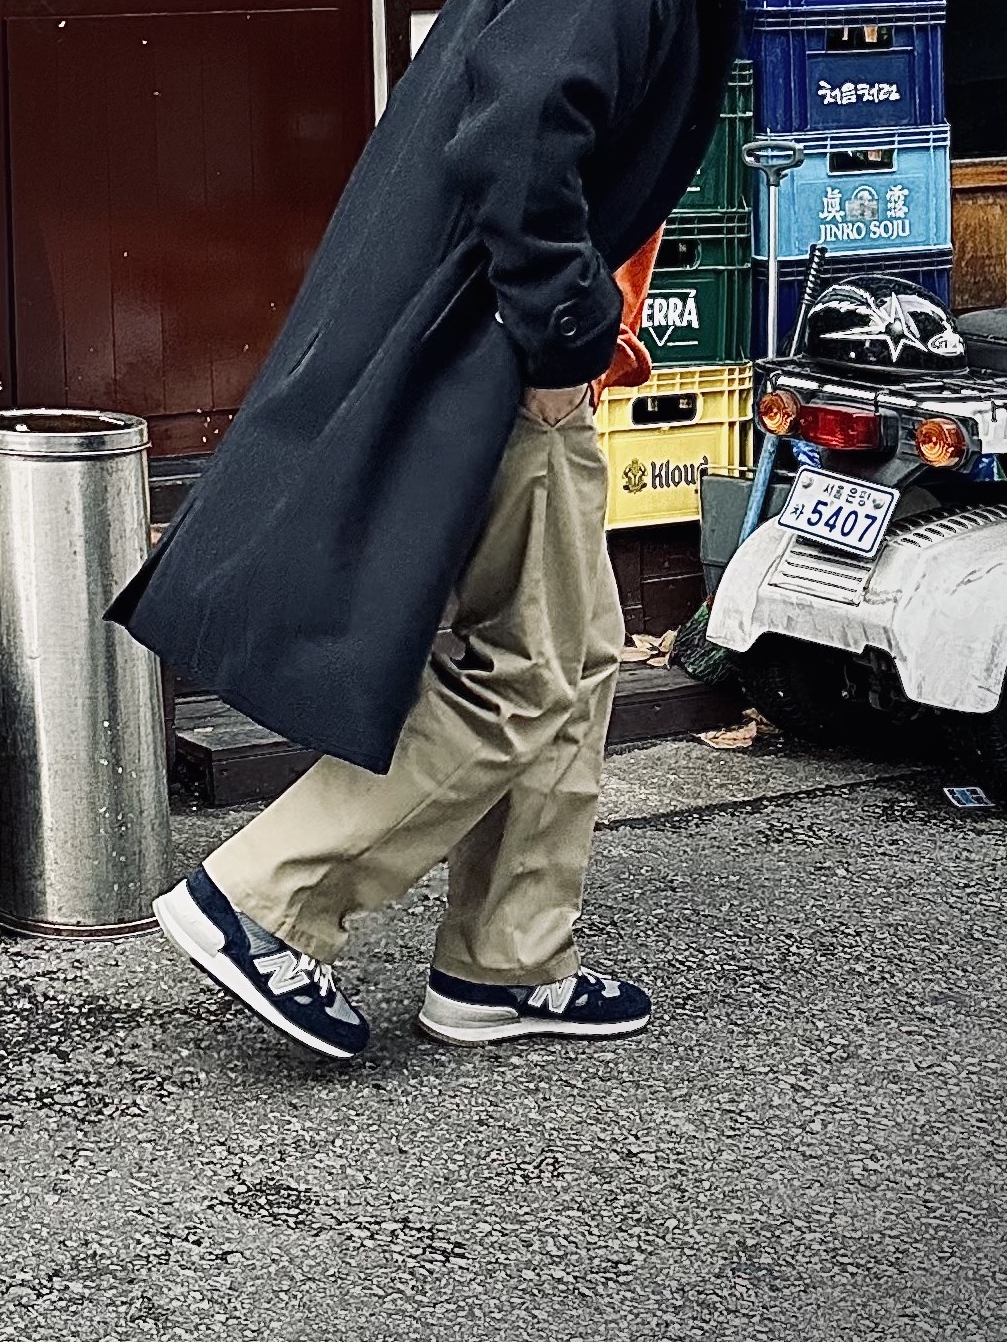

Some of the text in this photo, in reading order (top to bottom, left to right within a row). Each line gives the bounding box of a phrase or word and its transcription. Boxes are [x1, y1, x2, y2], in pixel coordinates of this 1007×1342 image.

[869, 219, 911, 240] SOJU
[641, 294, 700, 330] ERRA
[807, 499, 878, 543] 5407
